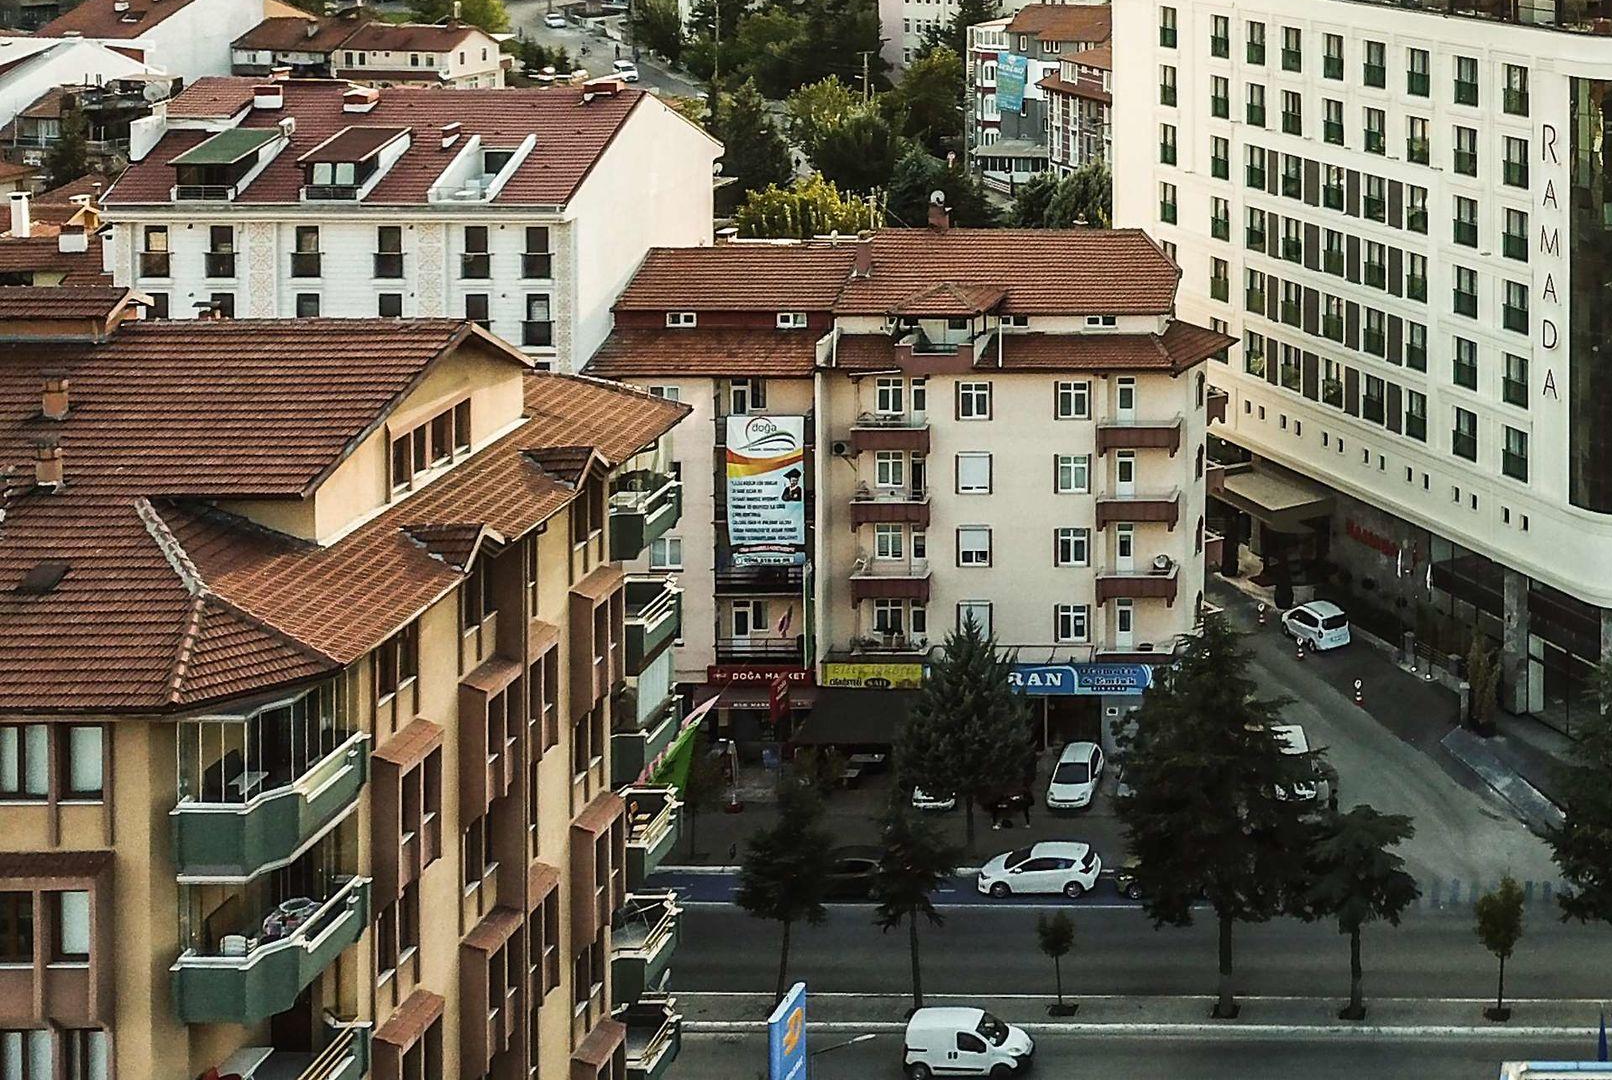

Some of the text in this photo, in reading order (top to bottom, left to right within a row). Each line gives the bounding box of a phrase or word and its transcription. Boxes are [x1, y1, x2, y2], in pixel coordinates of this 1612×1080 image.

[1540, 124, 1560, 400] RAMADA
[732, 671, 806, 680] DOĞA MAKET
